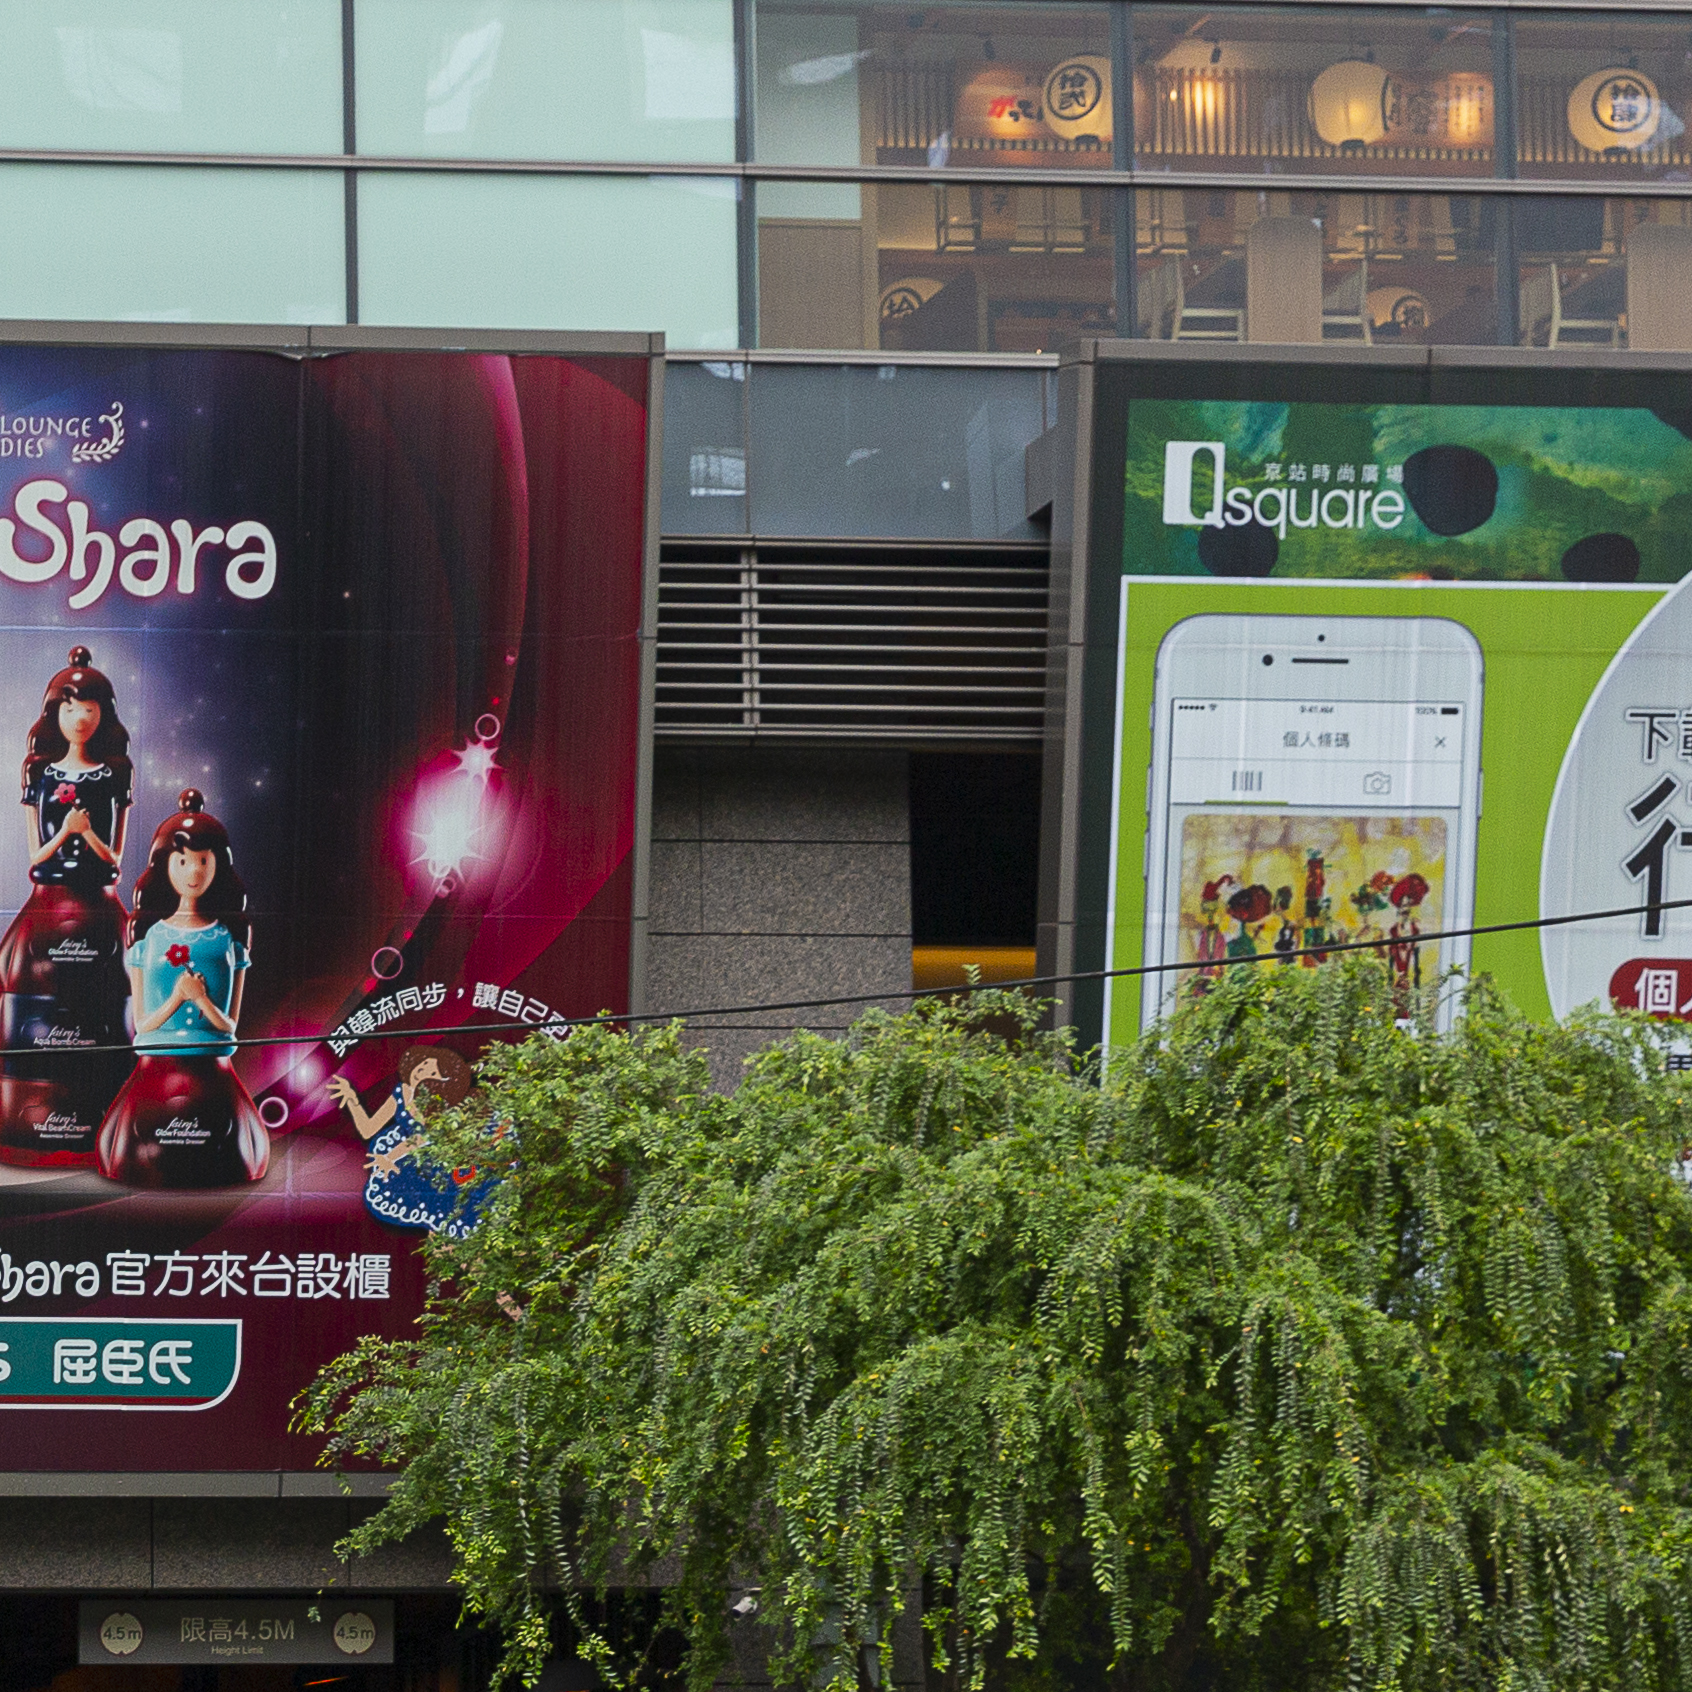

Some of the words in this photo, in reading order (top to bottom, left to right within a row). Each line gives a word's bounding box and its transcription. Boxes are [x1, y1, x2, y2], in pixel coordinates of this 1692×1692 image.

[0, 415, 93, 439] LOUNGE
[1264, 462, 1405, 484] 京站時尚廣場
[1283, 731, 1350, 748] 個人條碼
[1626, 707, 1692, 763] 下
[1634, 966, 1692, 1014] 個
[33, 1036, 50, 1047] Aqua
[173, 1128, 211, 1138] Foundation
[107, 1250, 393, 1301] 官方來台設櫃
[52, 1338, 193, 1386] 屈臣氏
[103, 1627, 126, 1640] 4.5
[127, 1630, 143, 1640] m
[180, 1616, 295, 1643] 限高4.5M
[336, 1627, 359, 1640] 4.5
[360, 1630, 376, 1640] m
[211, 1645, 241, 1657] Height
[242, 1645, 264, 1656] Limit
